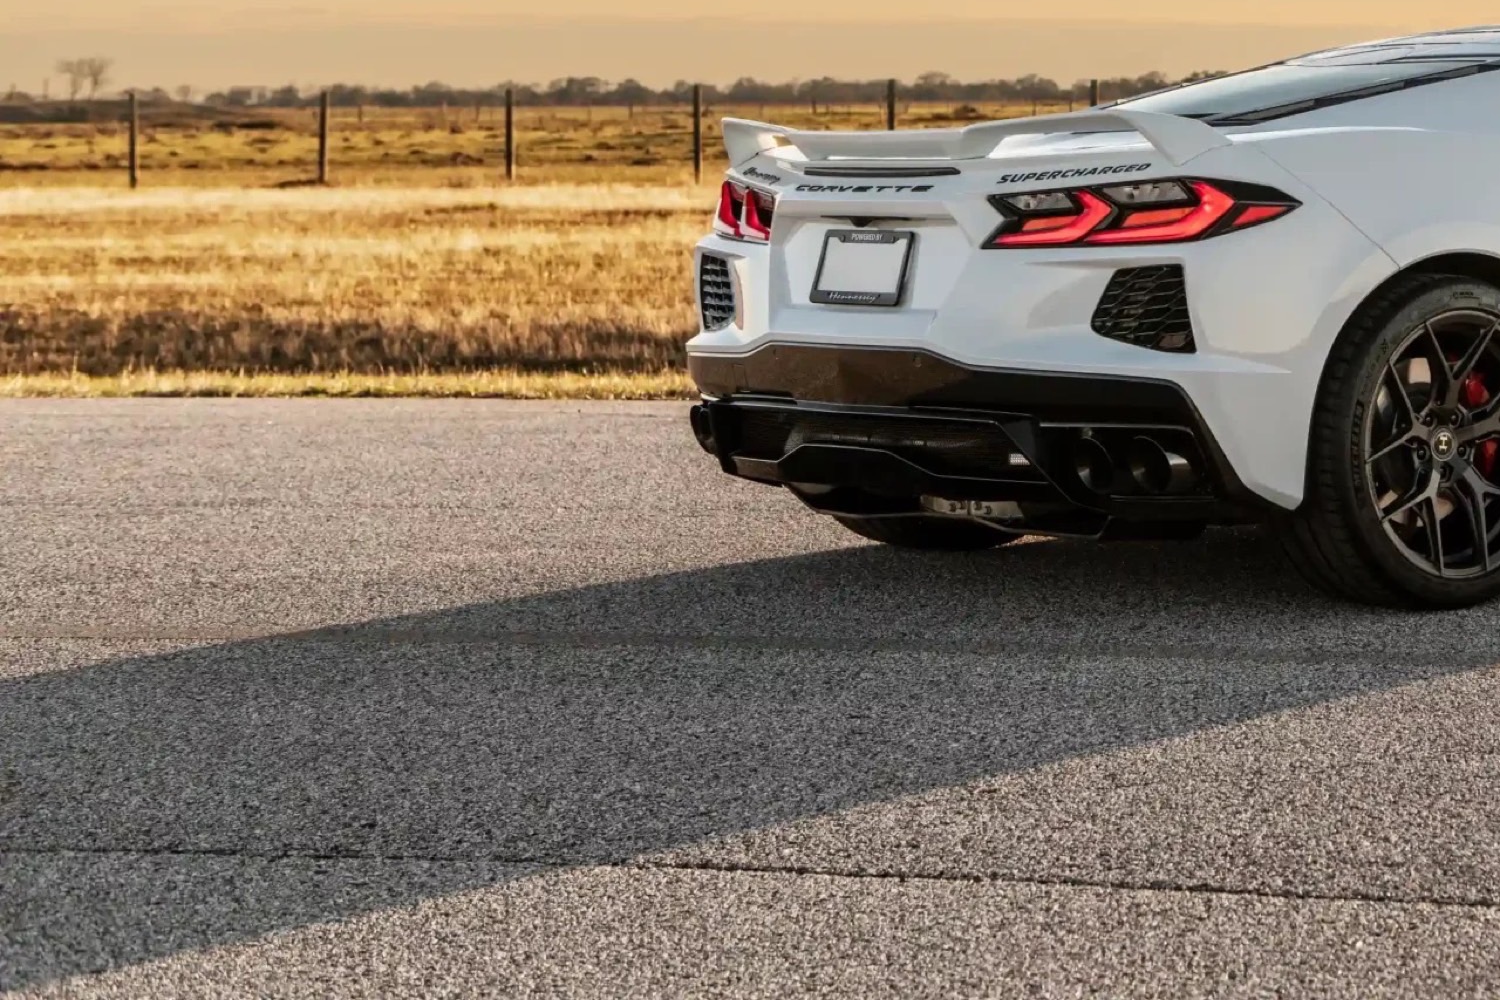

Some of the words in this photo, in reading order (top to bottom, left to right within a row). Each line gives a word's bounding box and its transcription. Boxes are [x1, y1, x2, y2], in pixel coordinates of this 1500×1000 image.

[996, 162, 1152, 184] SUPERCHARGED
[795, 184, 935, 193] CORVETTE
[851, 233, 875, 241] POWERED
[875, 233, 882, 241] BY
